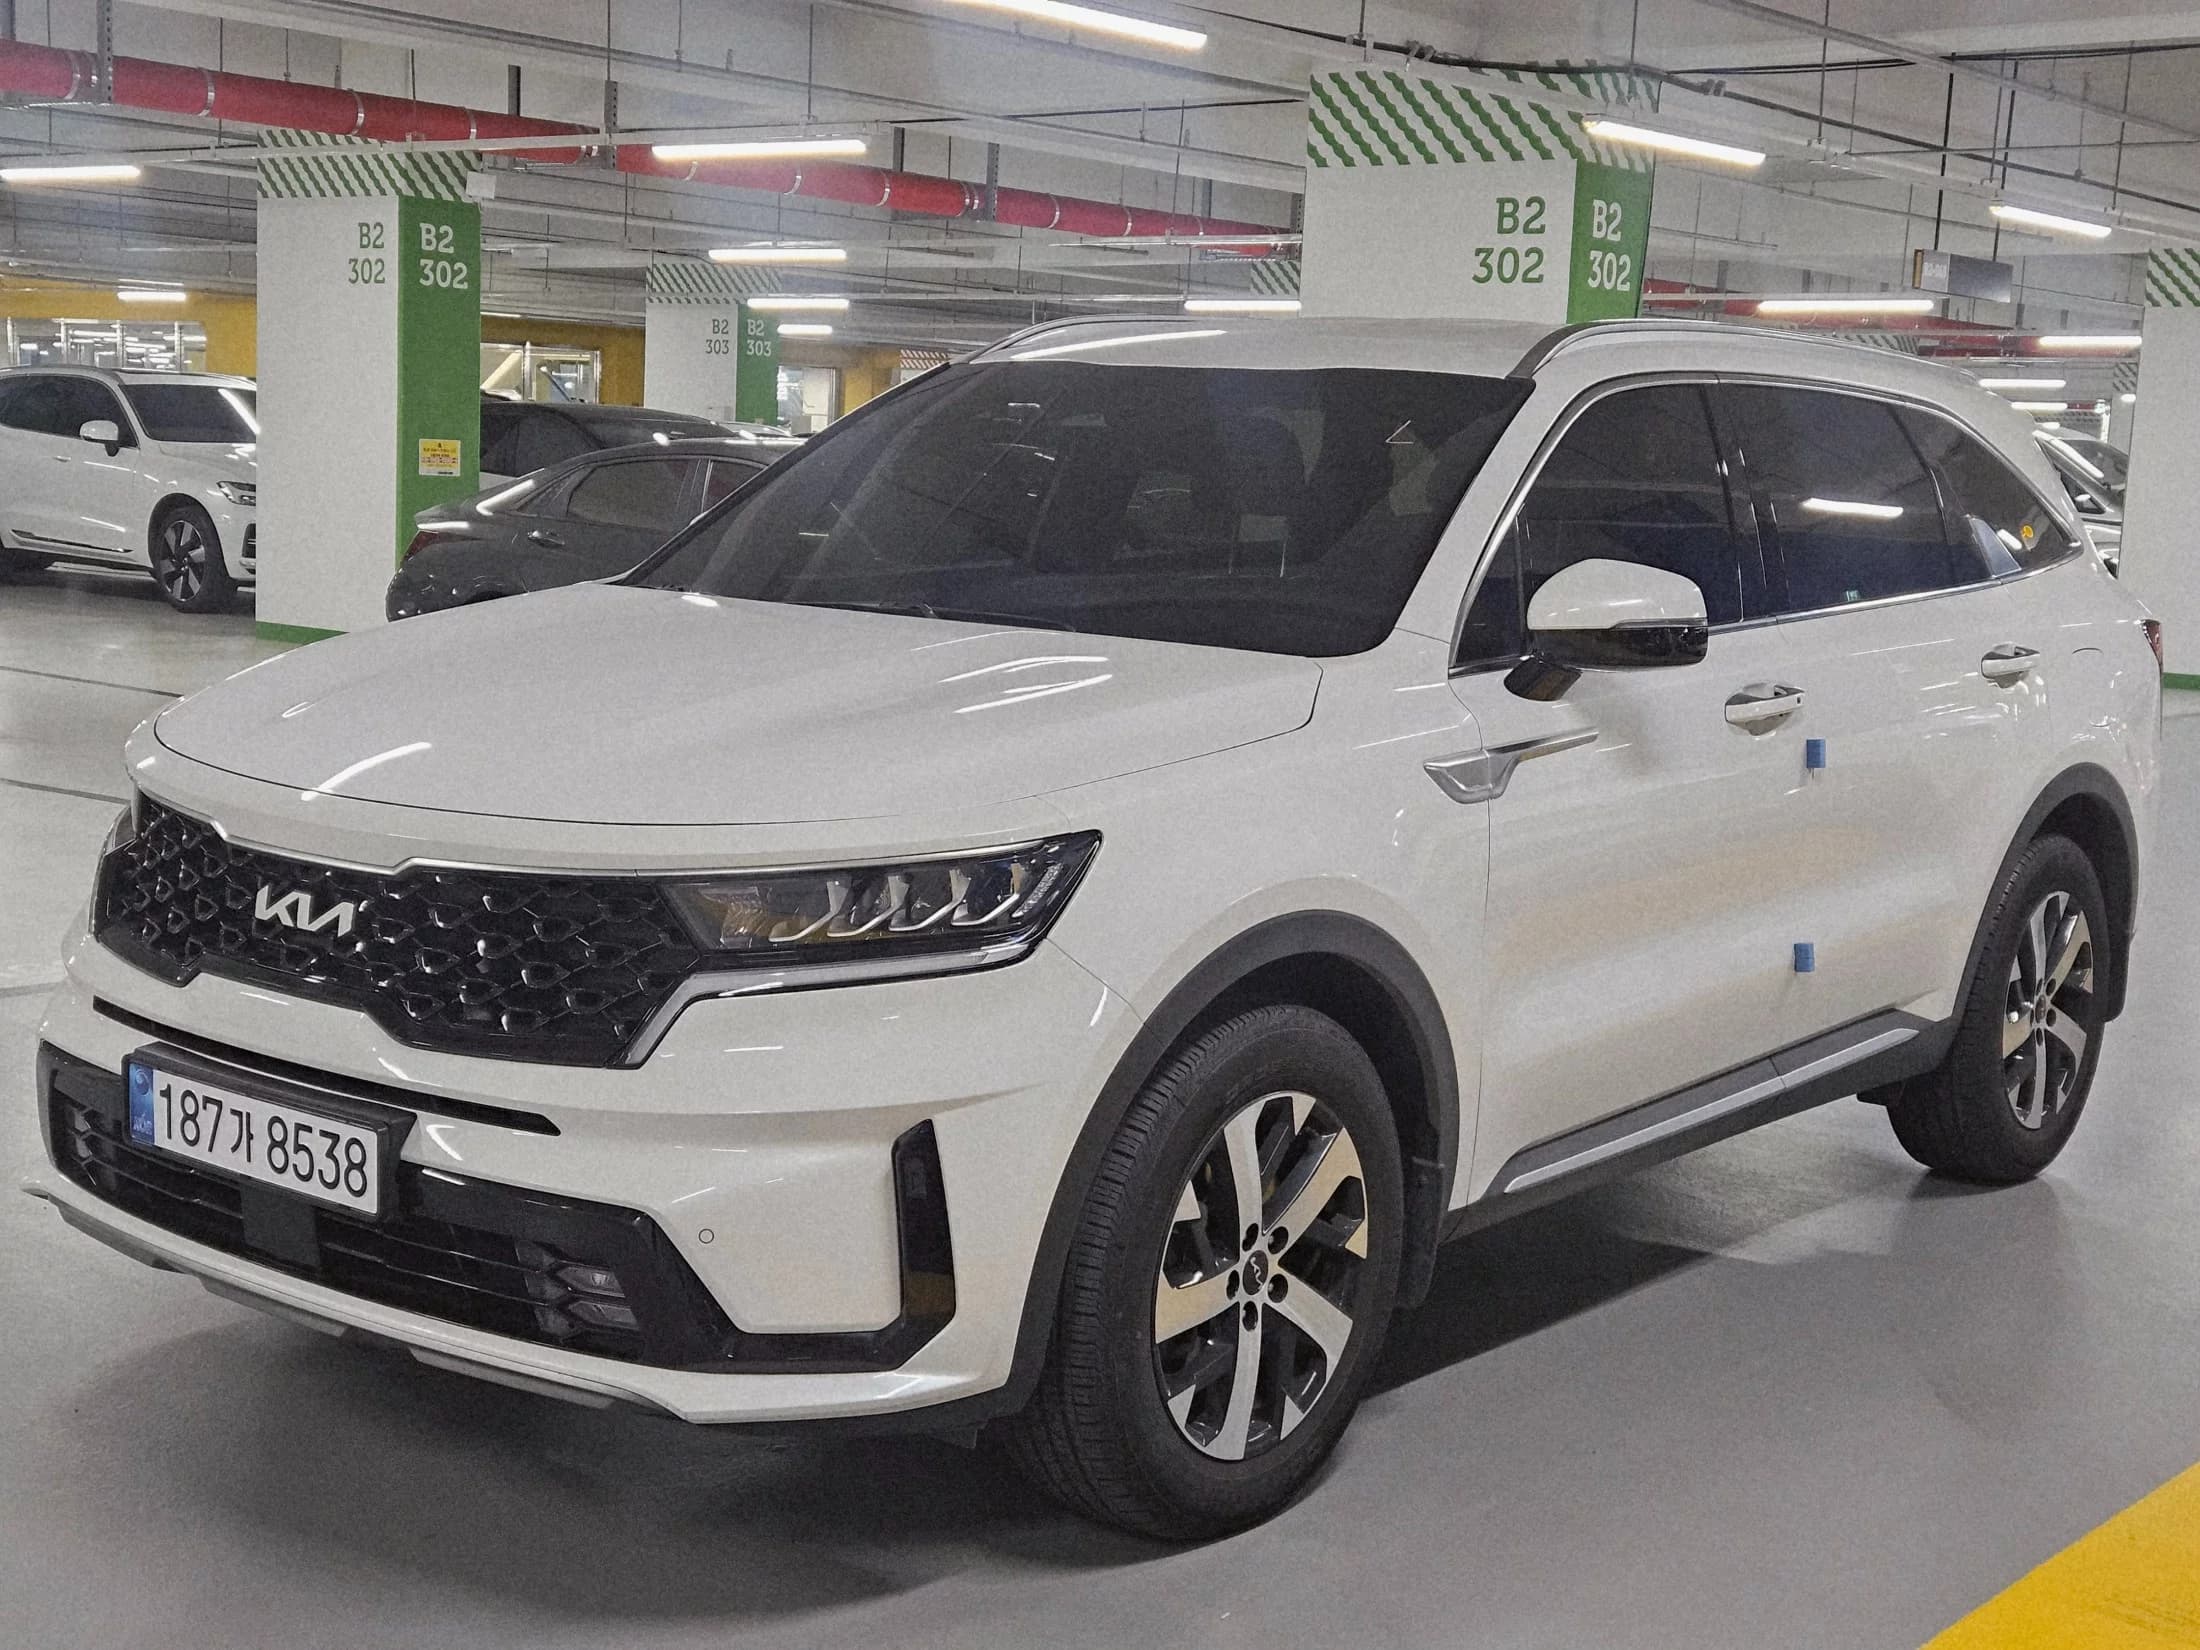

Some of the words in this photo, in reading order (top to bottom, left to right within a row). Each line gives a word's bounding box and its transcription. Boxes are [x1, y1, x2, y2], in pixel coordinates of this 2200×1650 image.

[1496, 196, 1546, 234] B2
[1592, 199, 1622, 242] B2
[358, 222, 384, 249] B2
[419, 223, 454, 254] B2
[348, 258, 386, 284] 302
[419, 259, 469, 289] 302
[1472, 247, 1544, 283] 302
[1588, 250, 1631, 292] 302
[712, 319, 729, 335] B2
[747, 319, 765, 336] B2
[705, 339, 729, 354] 303
[746, 339, 772, 357] 303
[254, 884, 354, 938] KIA
[159, 1083, 254, 1163] 187가
[266, 1115, 368, 1198] 8538
